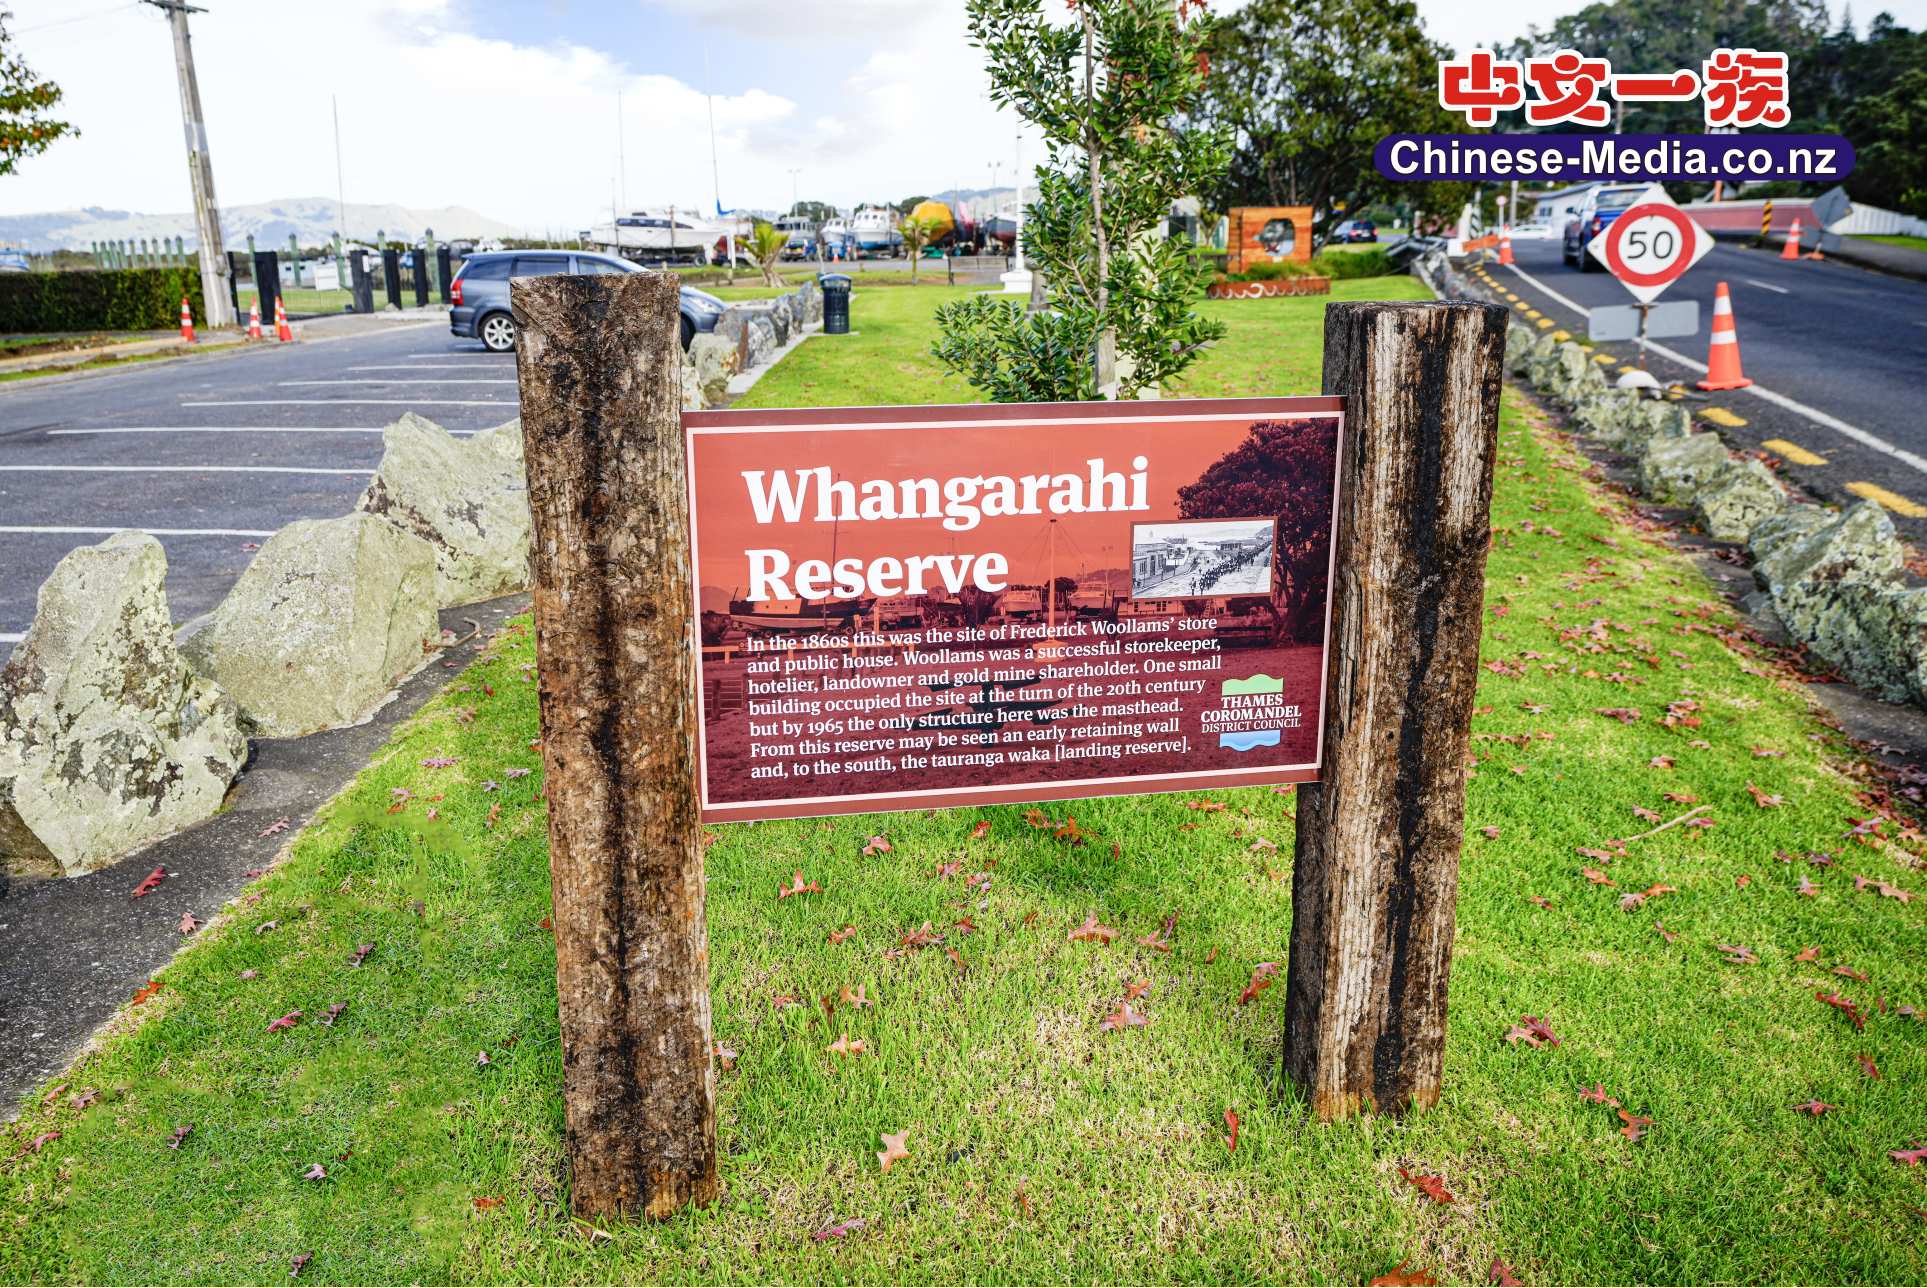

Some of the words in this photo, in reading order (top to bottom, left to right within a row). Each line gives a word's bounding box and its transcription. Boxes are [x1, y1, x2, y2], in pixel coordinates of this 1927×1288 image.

[1627, 231, 1674, 260] 50
[741, 456, 1150, 532] Whangarahi
[745, 549, 1009, 602] Reserve
[747, 637, 768, 652] In
[769, 636, 798, 651] the
[801, 634, 850, 650] 1860s
[853, 631, 886, 648] this
[888, 633, 922, 646] was
[926, 628, 953, 644] the
[957, 627, 986, 642] site
[990, 625, 1008, 641] of
[1011, 622, 1088, 639] Frederick
[1178, 617, 1218, 631] store
[748, 657, 781, 674] and
[785, 655, 839, 675] public
[843, 654, 899, 669] house.
[902, 649, 985, 666] Woollams
[988, 649, 1021, 662] was
[1024, 648, 1036, 660] a
[1038, 640, 1121, 659] successful
[1125, 638, 1221, 654] storekeeper,
[748, 678, 819, 695] hotelier,
[823, 674, 915, 689] landowner
[918, 670, 950, 686] and
[954, 668, 990, 687] gold
[994, 666, 1036, 682] mine
[1039, 661, 1140, 680] shareholder.
[1144, 659, 1176, 674] One
[1179, 655, 1221, 672] small
[749, 699, 822, 716] building
[825, 693, 902, 713] occupied
[905, 692, 932, 708] the
[936, 690, 965, 706] site
[969, 690, 985, 704] at
[989, 688, 1015, 703] the
[1019, 688, 1054, 701] turn
[1058, 683, 1075, 699] of
[1077, 683, 1103, 698] the
[1106, 680, 1141, 696] 20th
[1146, 679, 1207, 694] century
[1201, 706, 1302, 722] COROMANDEL
[1221, 694, 1283, 708] THAMES
[749, 722, 779, 737] but
[782, 720, 804, 738] by
[808, 718, 844, 737] 1965
[848, 716, 875, 732] the
[879, 714, 916, 732] only
[919, 712, 994, 727] structure
[997, 708, 1033, 723] here
[1037, 708, 1069, 720] was
[1073, 703, 1098, 718] the
[1102, 698, 1184, 716] masthead.
[1202, 721, 1251, 733] DISTRICT
[1254, 718, 1301, 730] COUNCIL
[750, 743, 795, 758] From
[799, 739, 831, 755] this
[834, 739, 895, 753] reserve
[899, 737, 935, 751] may
[938, 732, 958, 747] be
[962, 733, 999, 745] seen
[1003, 731, 1023, 743] an
[1027, 725, 1067, 743] early
[1071, 721, 1144, 739] retaining
[1147, 718, 1180, 734] wall
[751, 762, 789, 779] and,
[793, 763, 810, 776] to
[814, 760, 841, 775] the
[845, 756, 897, 773] south,
[901, 754, 928, 770] the
[931, 753, 1004, 768] tauranga
[1008, 747, 1051, 763] waka
[1055, 743, 1122, 762] [landing
[1125, 736, 1191, 755] reserve].
